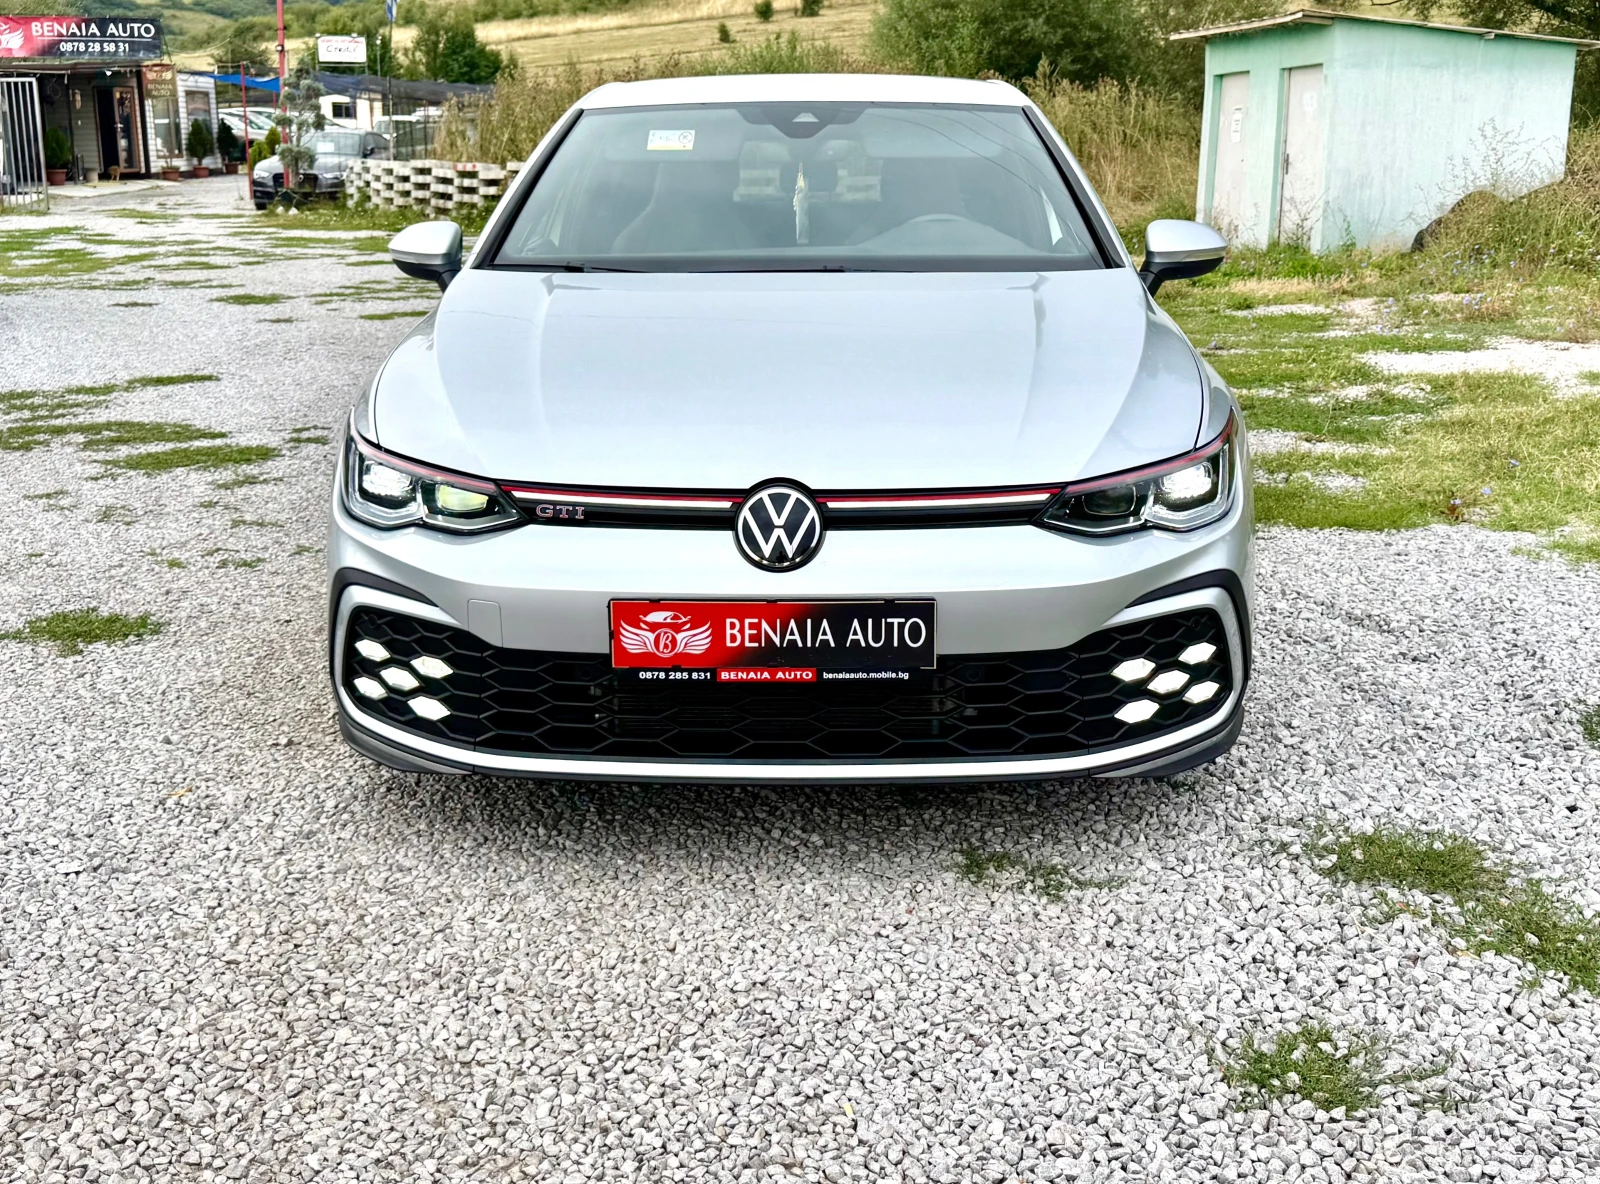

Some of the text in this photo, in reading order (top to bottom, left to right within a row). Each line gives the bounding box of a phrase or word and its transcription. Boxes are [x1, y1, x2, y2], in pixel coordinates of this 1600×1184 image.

[31, 21, 156, 38] BENAIA AUTO
[59, 42, 130, 52] 0878 28 58 31
[536, 504, 585, 520] GTI
[725, 617, 927, 649] BENAIA AUTO
[639, 671, 909, 680] 0878 285 831 BENAIA AUTO benaiaauto.mobile.bg
